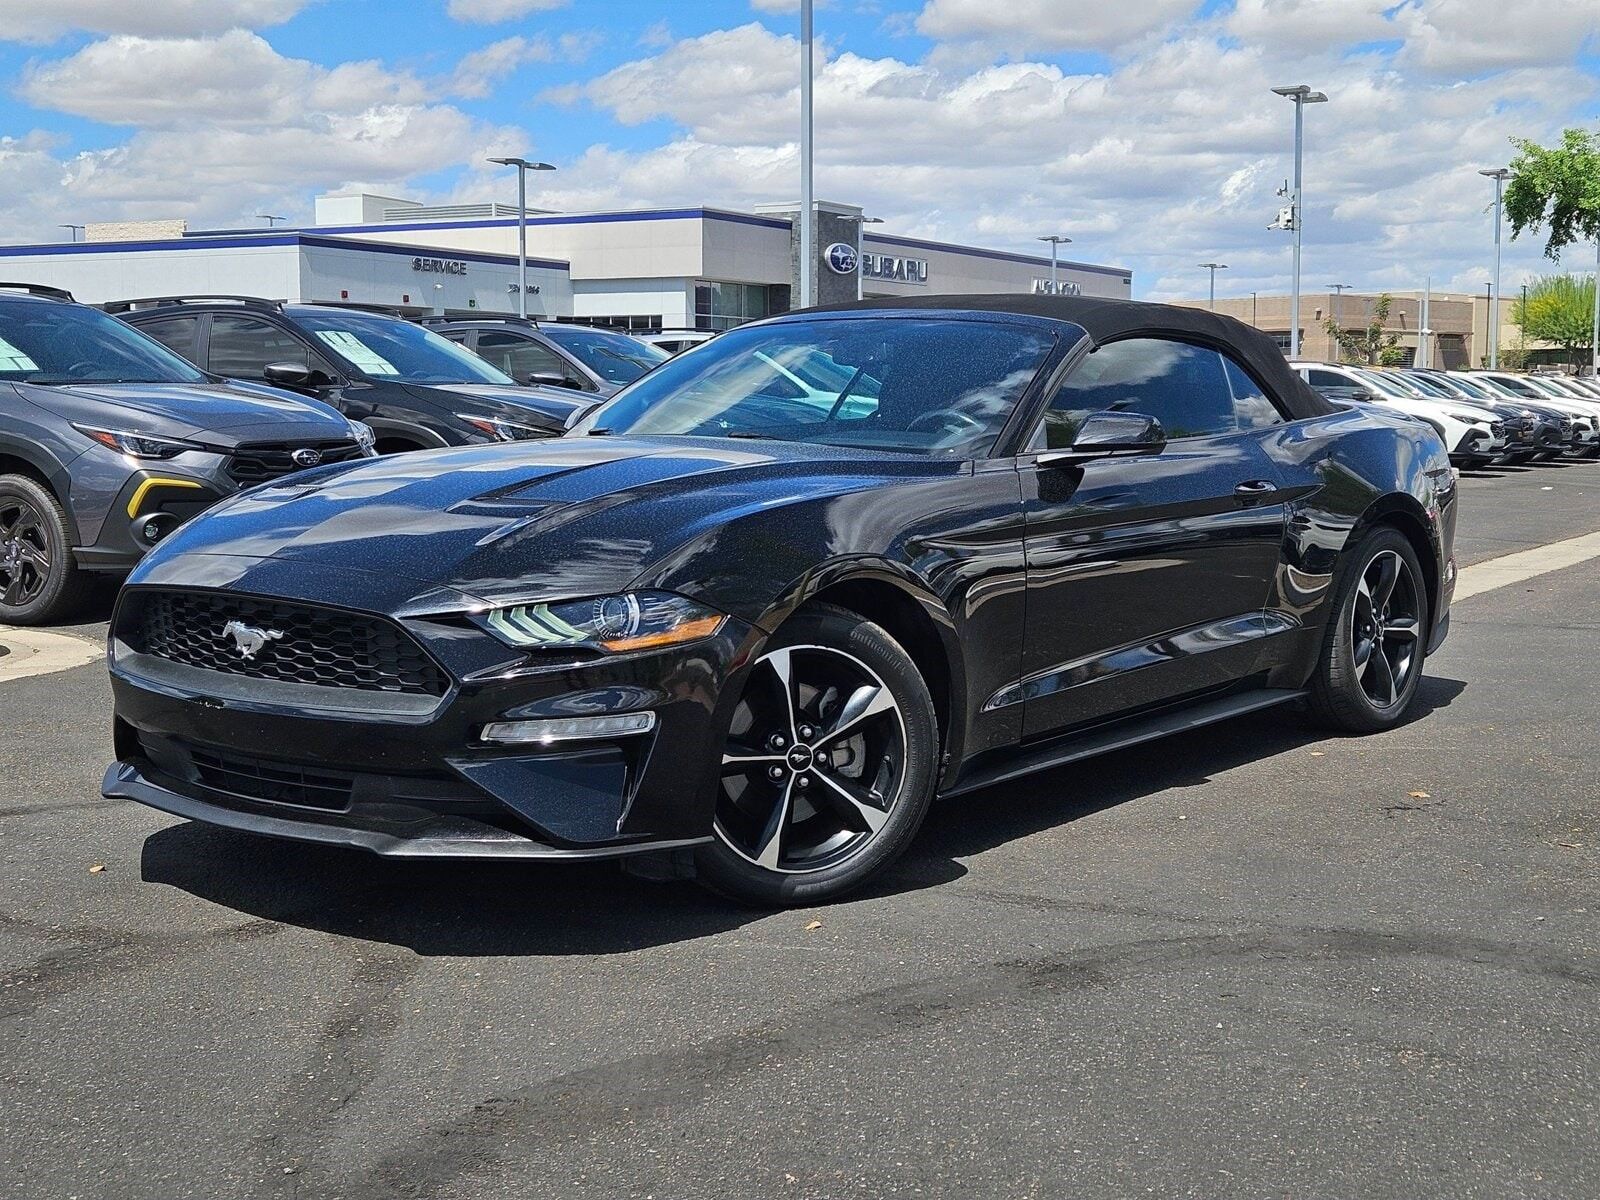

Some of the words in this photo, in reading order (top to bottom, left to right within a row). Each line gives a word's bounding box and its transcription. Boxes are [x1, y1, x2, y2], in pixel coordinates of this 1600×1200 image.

[412, 257, 467, 275] SERVICE
[862, 254, 928, 282] SUBARU
[849, 629, 903, 672] ontinental
